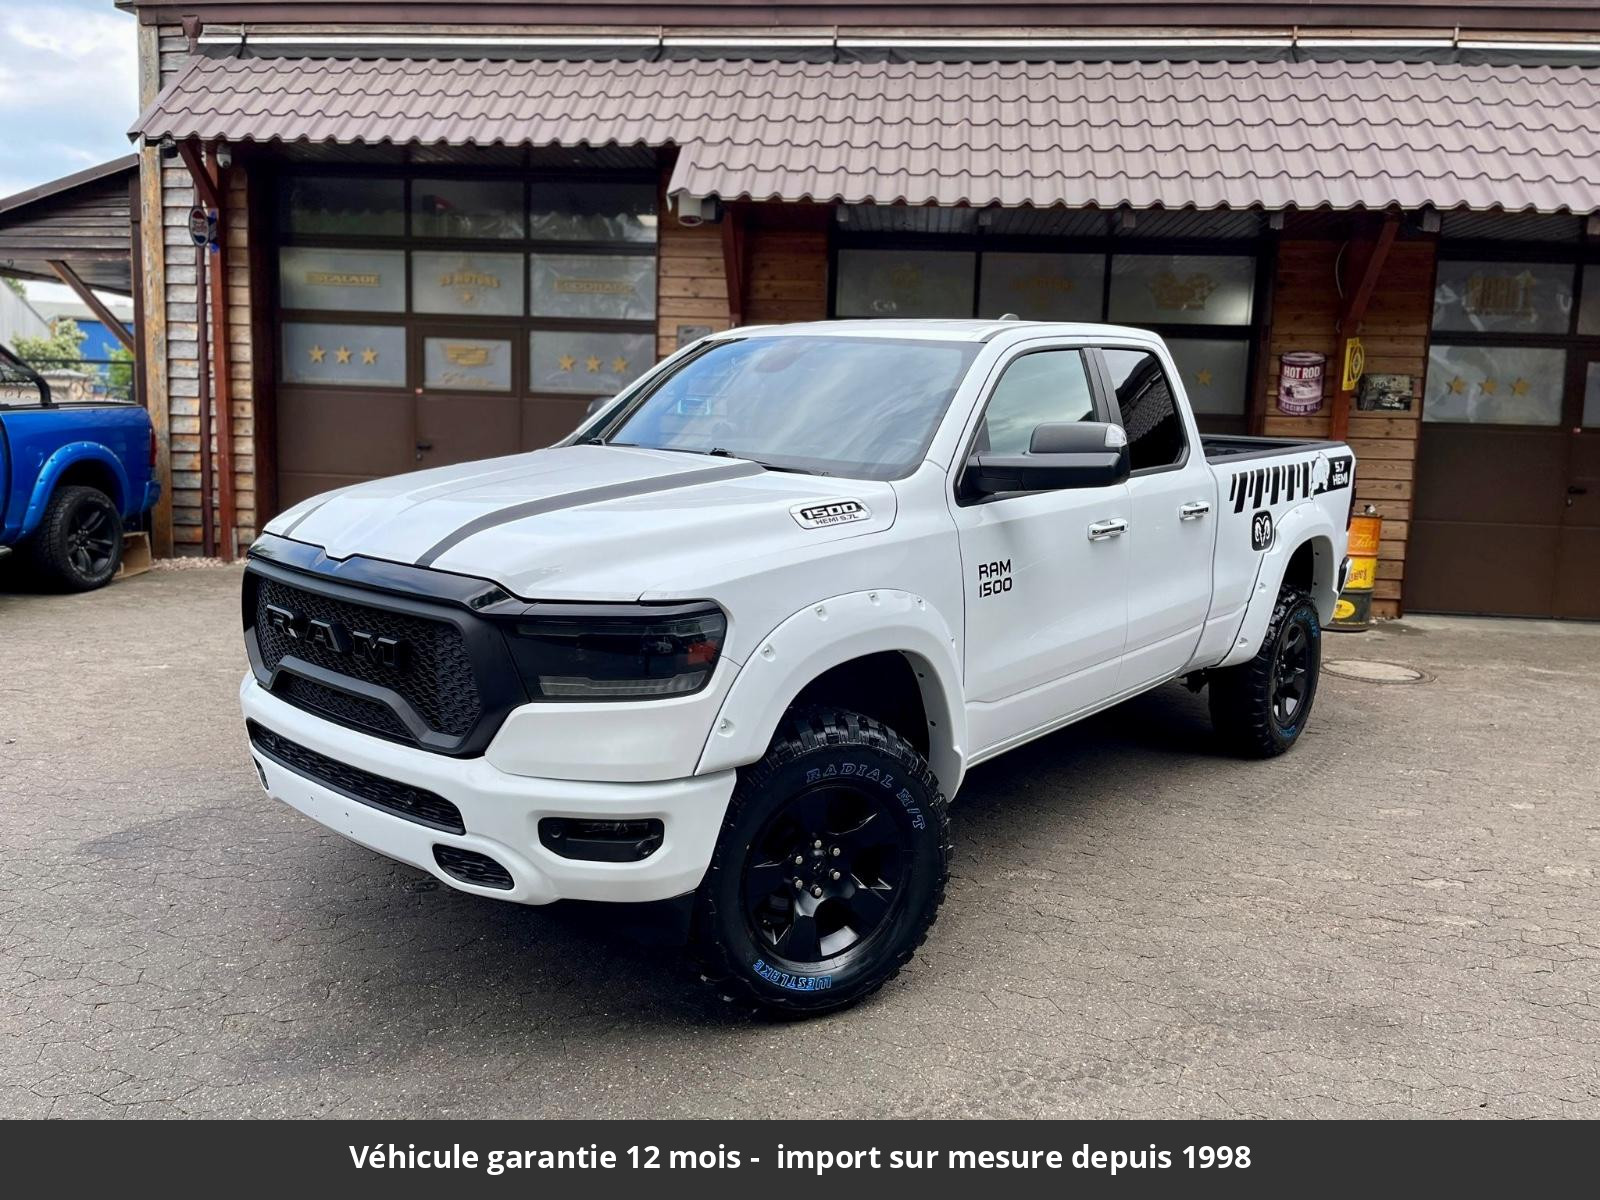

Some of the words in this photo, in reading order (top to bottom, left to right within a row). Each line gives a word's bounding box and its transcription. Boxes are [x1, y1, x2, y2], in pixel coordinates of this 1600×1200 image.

[1283, 366, 1302, 379] HOT
[1302, 366, 1321, 379] ROD
[1332, 471, 1348, 486] HEMI
[801, 503, 858, 519] 1500
[815, 517, 839, 525] HEMI
[841, 513, 859, 521] 5.7L
[978, 559, 1012, 580] RAM
[978, 577, 1013, 598] 1500
[266, 604, 398, 666] RAM
[806, 762, 894, 788] RADIAL
[753, 959, 832, 991] WESTLAKE
